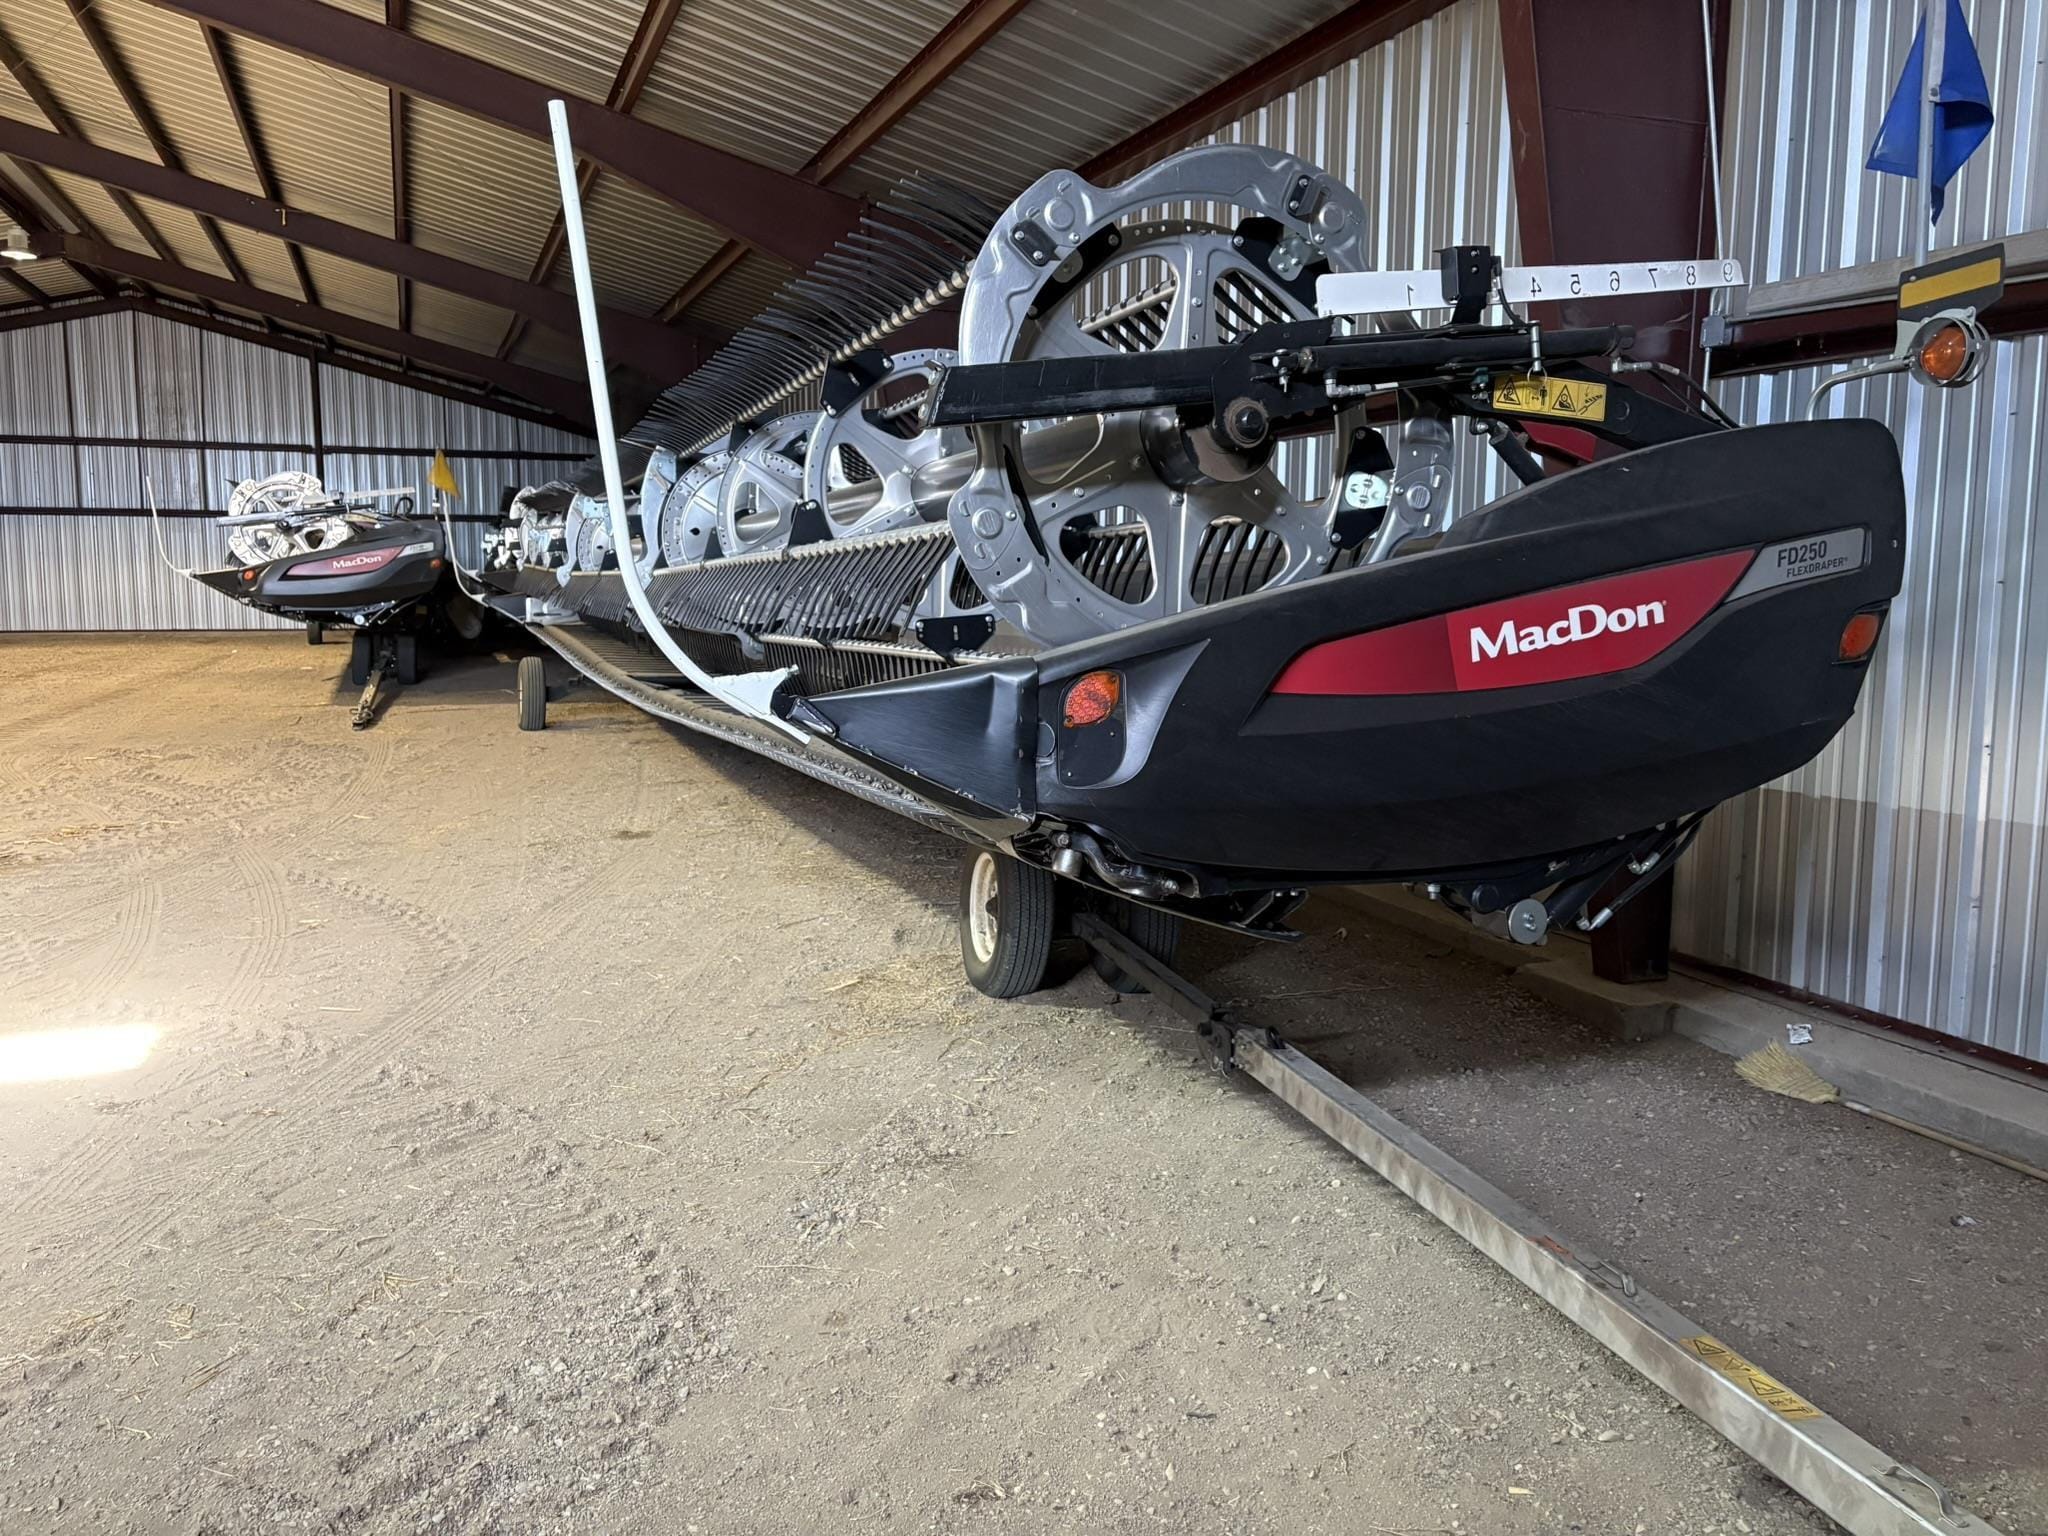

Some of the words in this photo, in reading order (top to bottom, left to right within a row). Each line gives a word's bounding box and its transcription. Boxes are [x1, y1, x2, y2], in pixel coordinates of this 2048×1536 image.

[332, 555, 382, 569] MacDon
[1777, 540, 1828, 568] FD250
[1470, 600, 1667, 663] MacDon
